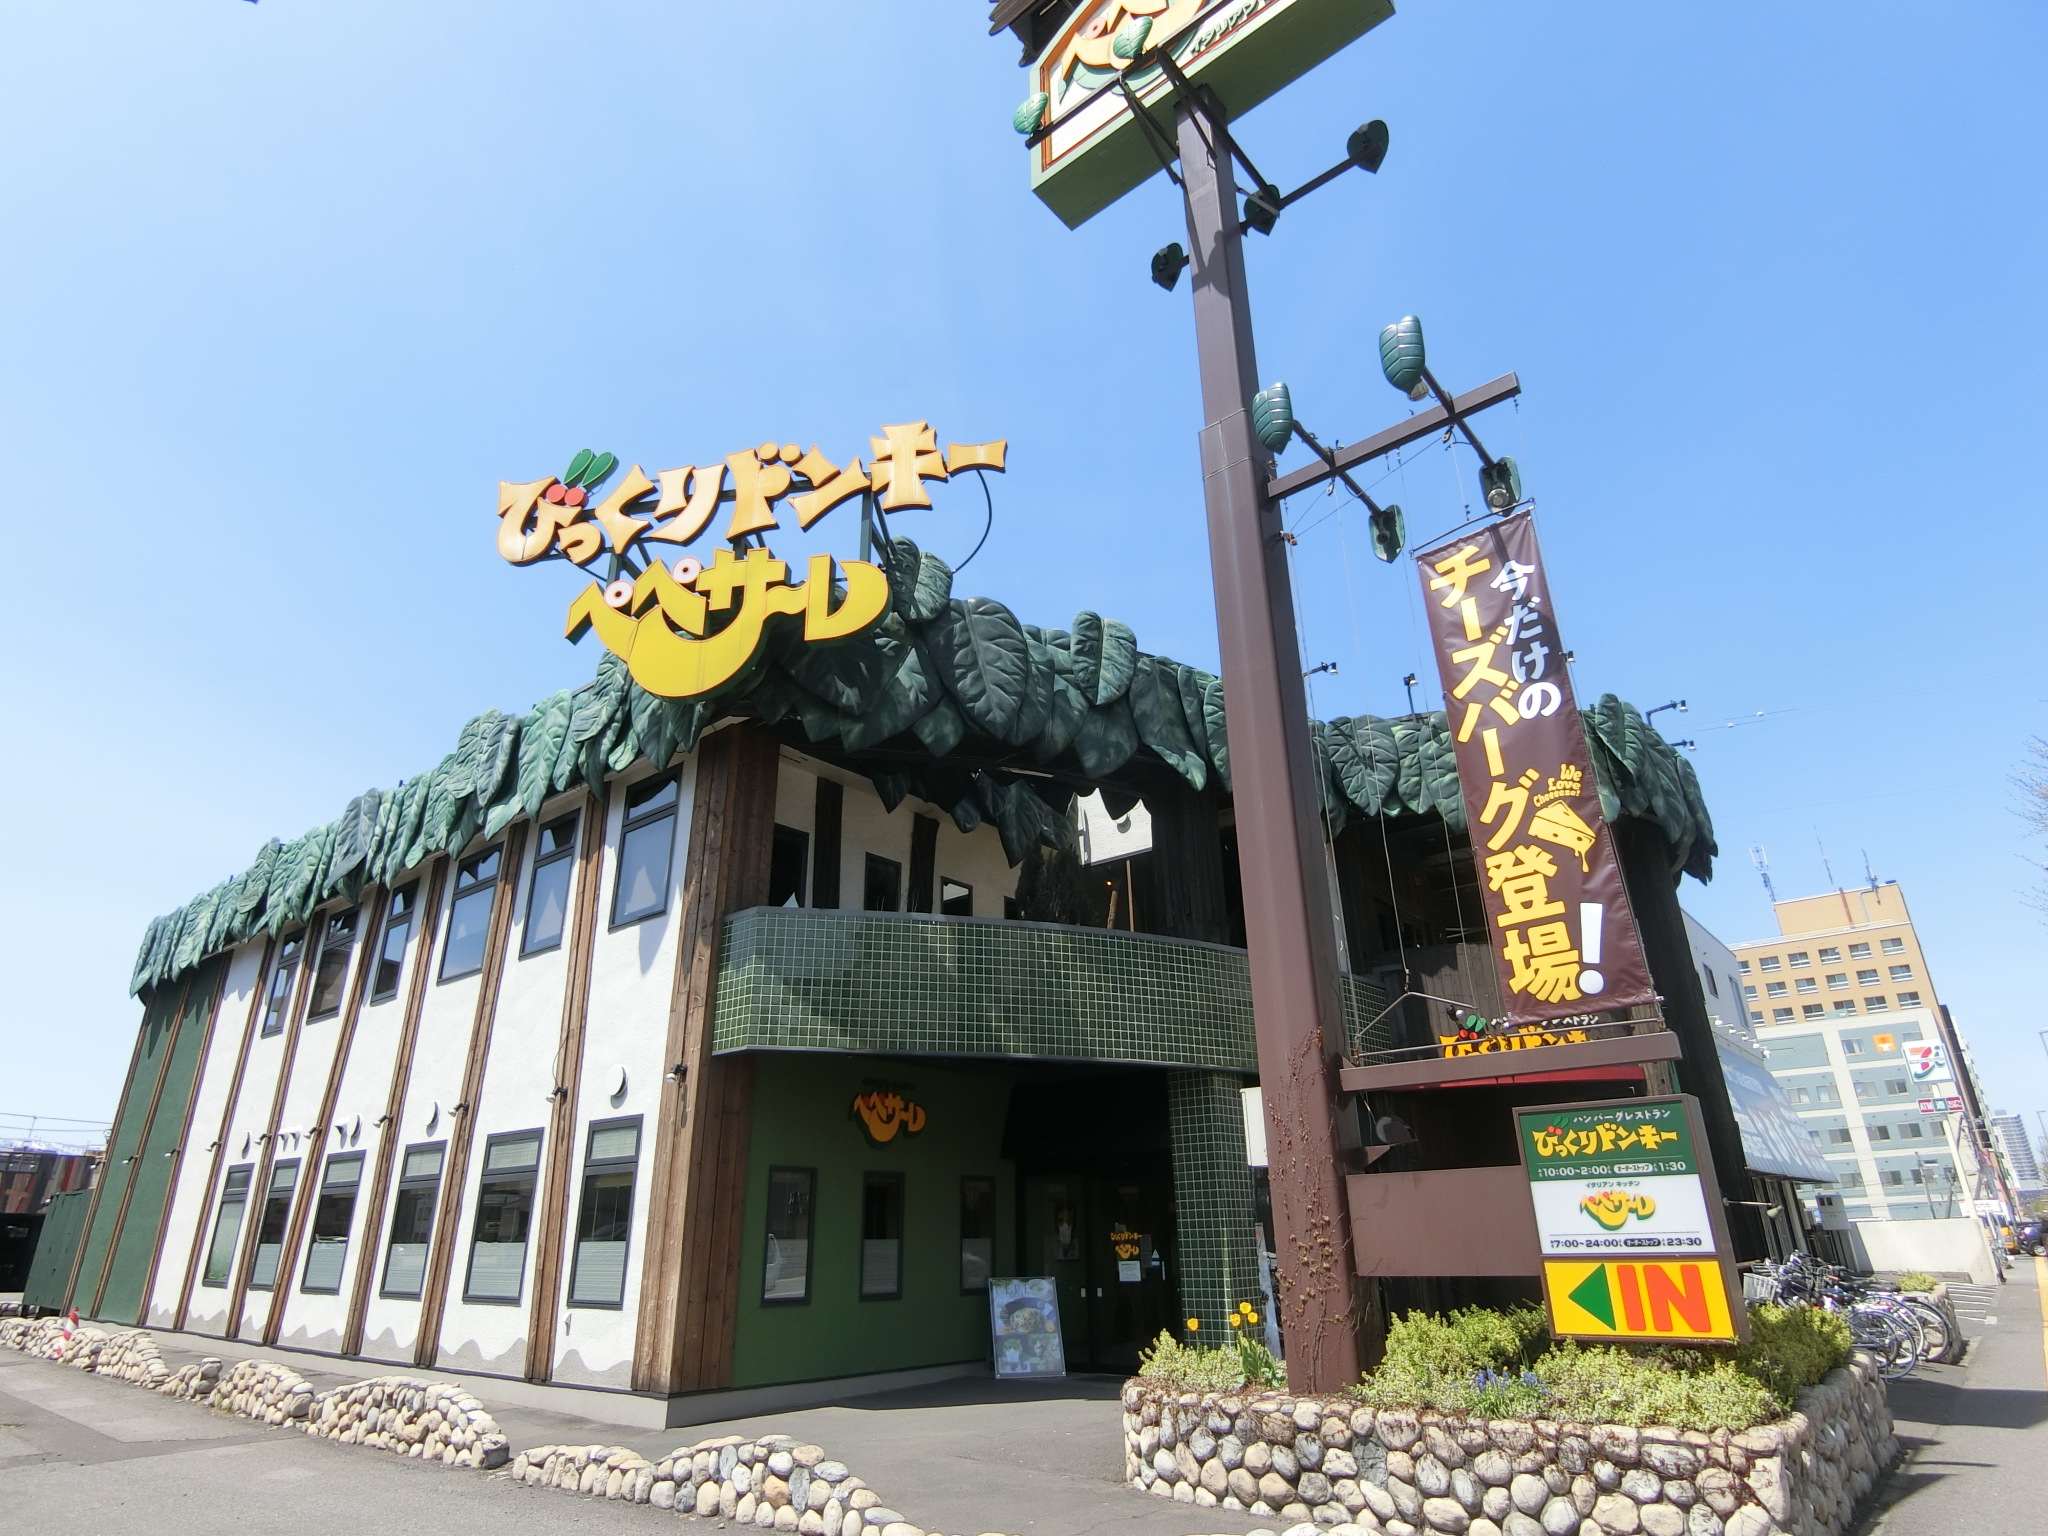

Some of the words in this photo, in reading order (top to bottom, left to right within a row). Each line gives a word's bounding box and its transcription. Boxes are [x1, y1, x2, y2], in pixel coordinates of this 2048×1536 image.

[497, 420, 1007, 566] びっくりドンキー
[1490, 559, 1561, 720] 今だけの
[1560, 763, 1583, 782] We
[1547, 777, 1582, 792] Love
[1573, 1109, 1671, 1123] ハンバーグレストラン
[1532, 1122, 1679, 1158] びっくりドンキー
[1586, 1181, 1615, 1189] イタリアン
[1667, 1237, 1702, 1247] 23:30
[1617, 1264, 1712, 1333] IN
